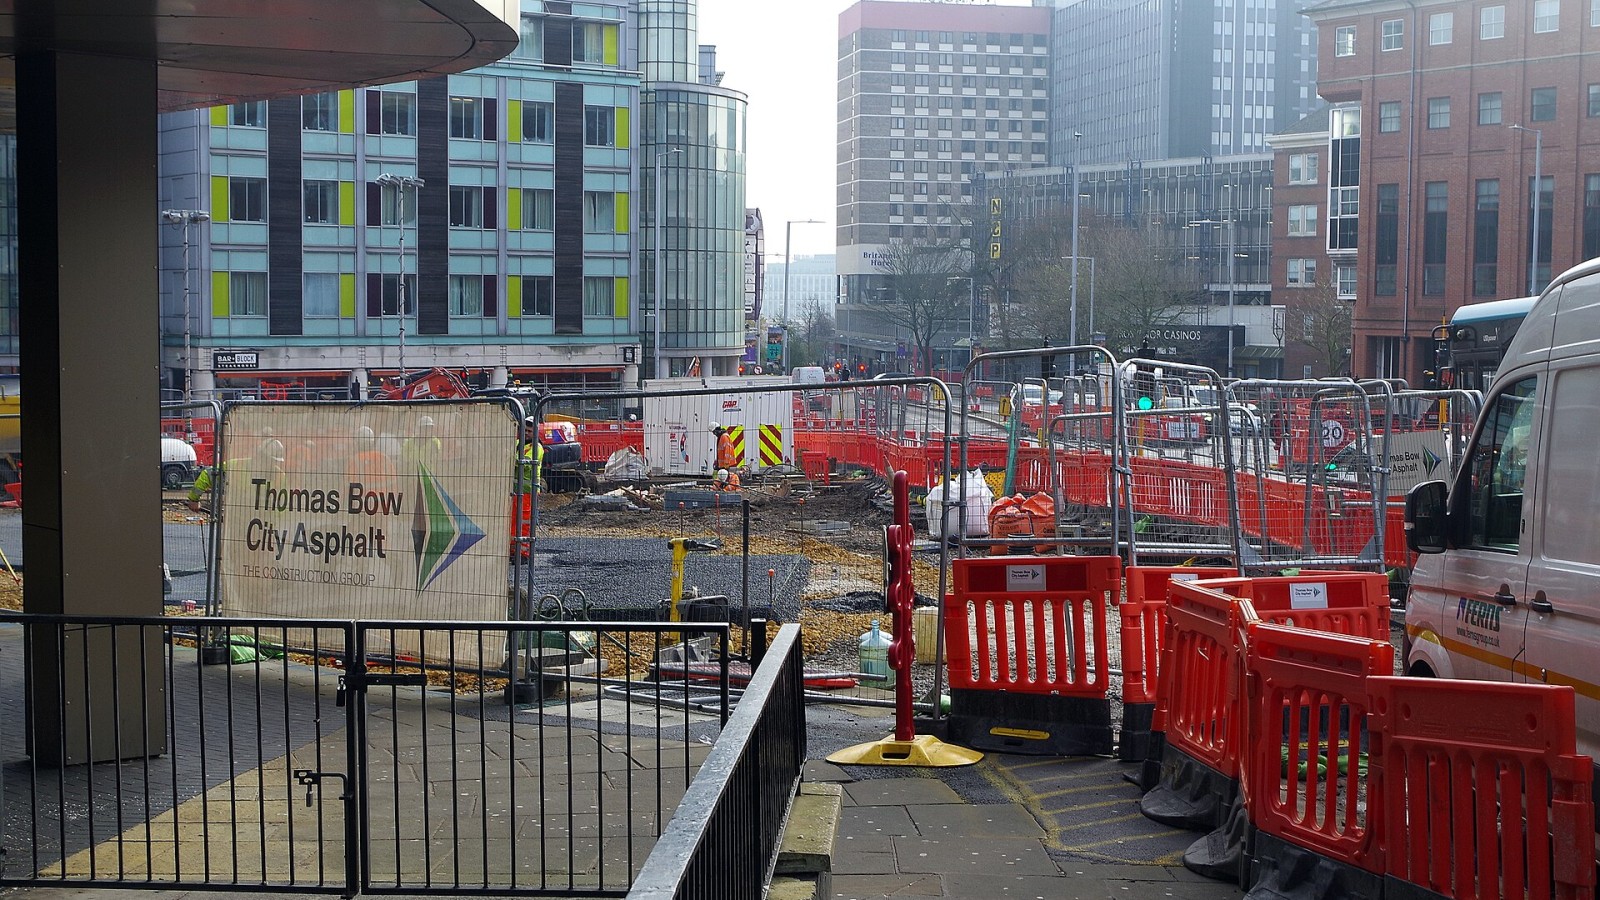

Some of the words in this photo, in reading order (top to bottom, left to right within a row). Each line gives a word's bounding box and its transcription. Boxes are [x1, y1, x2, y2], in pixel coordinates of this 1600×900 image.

[1163, 330, 1201, 341] CASINOS
[1322, 426, 1342, 440] 20
[1377, 453, 1404, 463] Tmas
[1405, 451, 1420, 461] Bow
[1392, 462, 1418, 475] Asphalt
[251, 478, 340, 514] Thomas
[348, 482, 403, 516] Bow
[246, 518, 287, 561] City
[291, 522, 387, 563] Asphalt
[243, 564, 260, 578] THE
[262, 566, 338, 584] CONSTRUCTION
[340, 571, 375, 586] GROUP
[1465, 599, 1503, 632] FERNS
